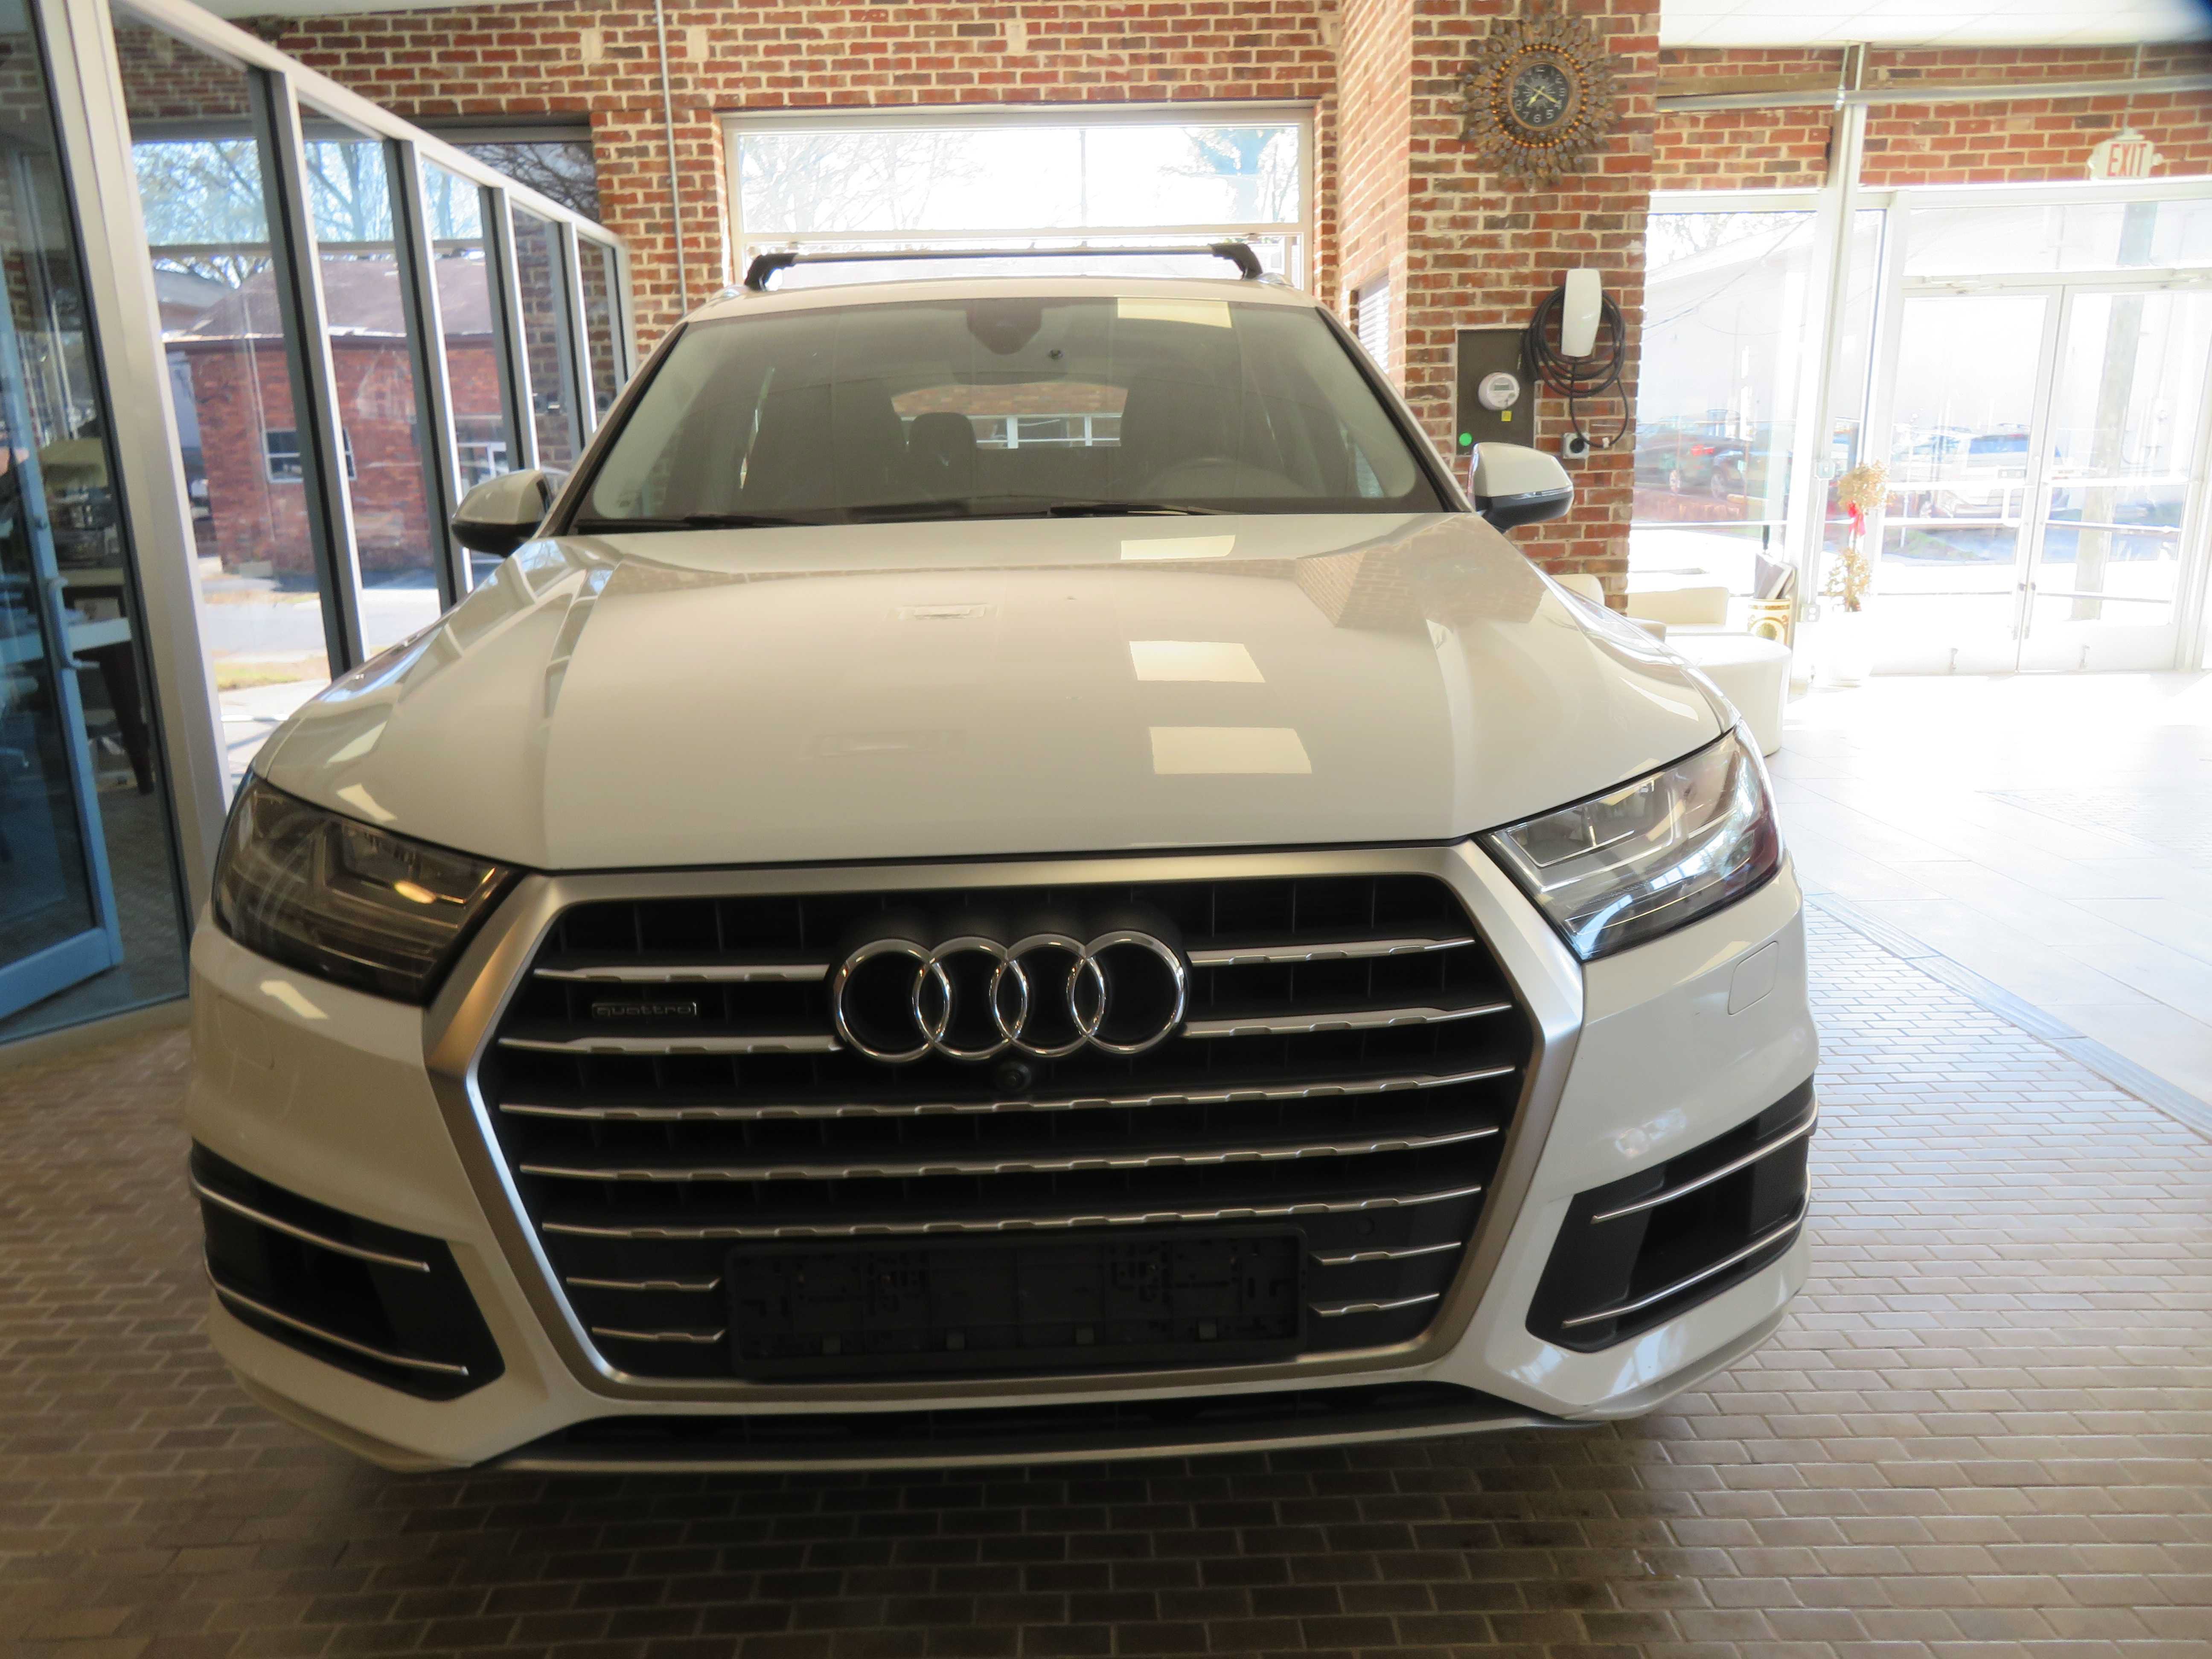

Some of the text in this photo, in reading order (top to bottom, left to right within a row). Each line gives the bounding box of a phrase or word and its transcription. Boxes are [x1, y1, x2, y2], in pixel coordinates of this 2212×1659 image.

[1522, 111, 1530, 120] 7
[1533, 114, 1541, 123] 6
[1546, 109, 1554, 119] 5
[2107, 143, 2147, 176] EXIT
[597, 1005, 691, 1018] quattro
